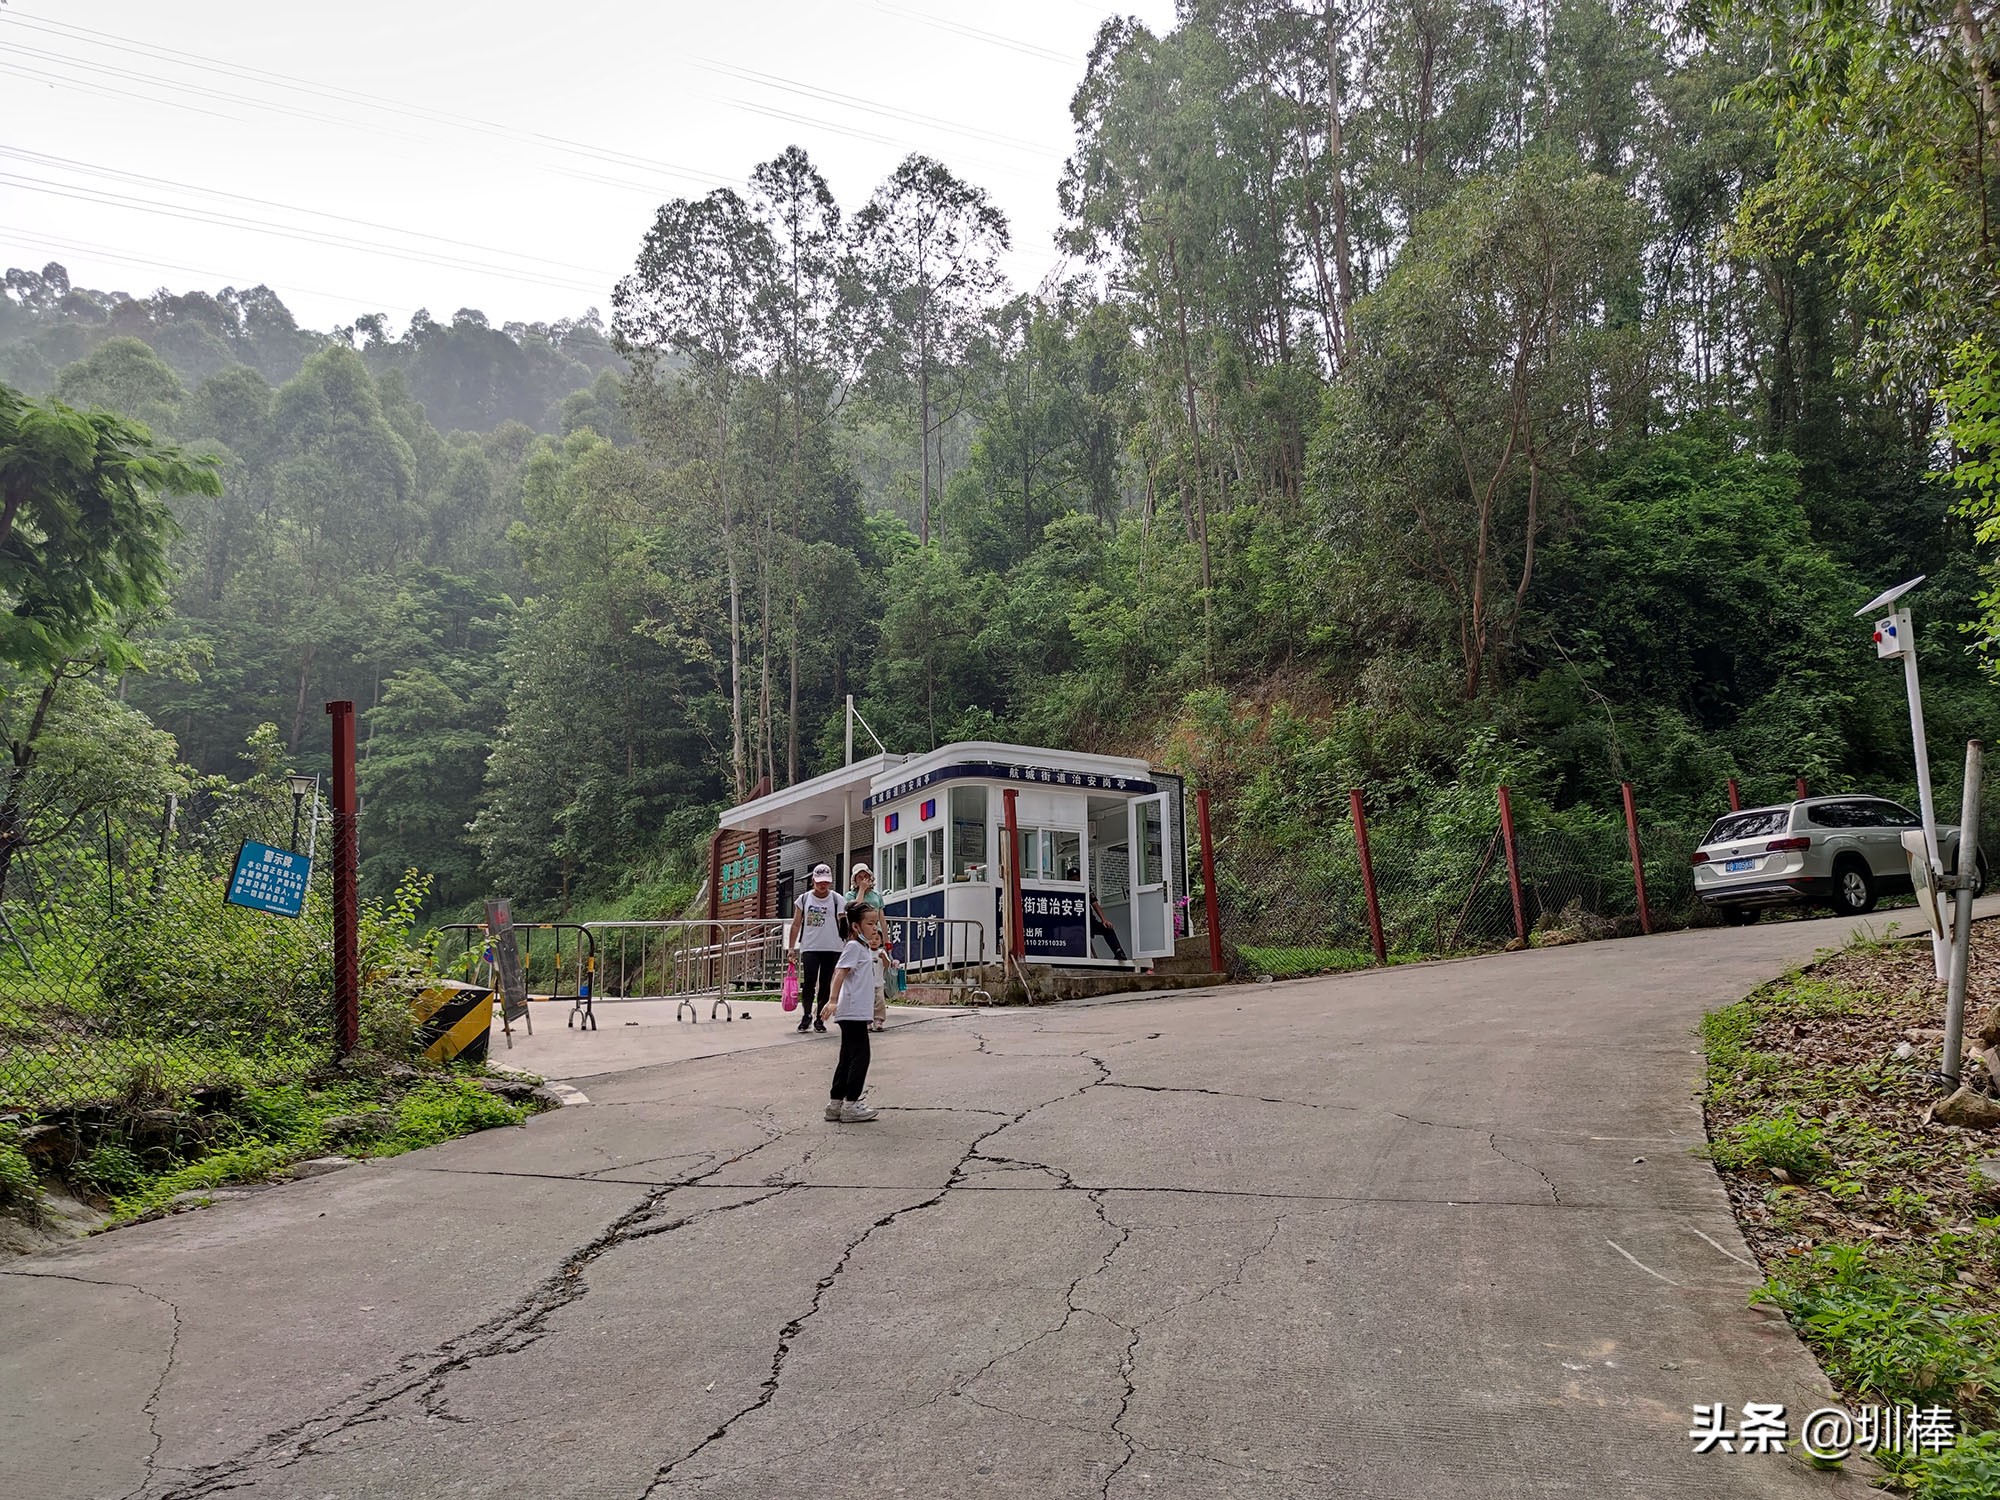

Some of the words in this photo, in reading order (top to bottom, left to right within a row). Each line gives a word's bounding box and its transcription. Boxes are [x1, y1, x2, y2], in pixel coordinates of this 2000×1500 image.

[1008, 767, 1127, 789] 航城街道治安岗亭
[263, 849, 293, 868] 警示牌
[998, 896, 1085, 917] 街道治安亭
